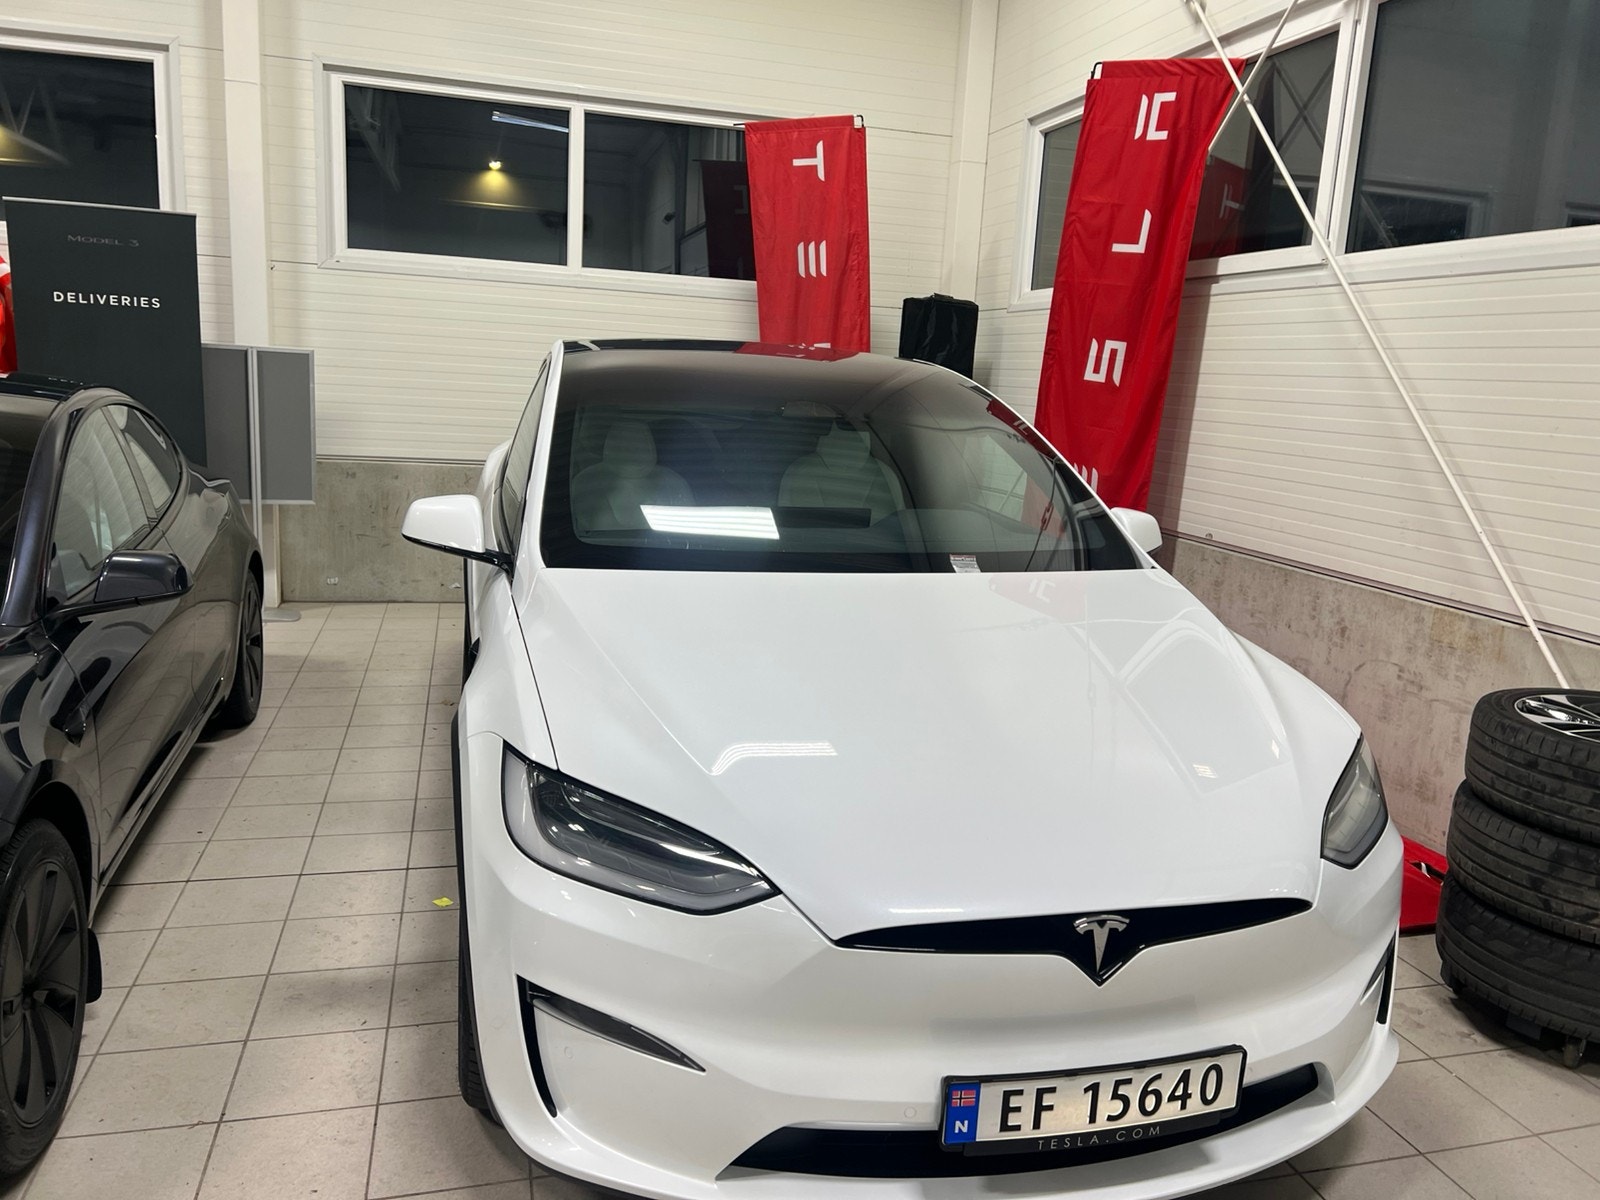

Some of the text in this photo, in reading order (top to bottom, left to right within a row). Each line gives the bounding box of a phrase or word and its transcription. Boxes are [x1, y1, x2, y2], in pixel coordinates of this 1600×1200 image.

[67, 234, 140, 247] MODEL 3
[53, 291, 161, 309] DELIVERIES
[999, 1063, 1224, 1133] EF 15640
[954, 1120, 969, 1133] N
[1038, 1126, 1161, 1150] TESLA.COM
